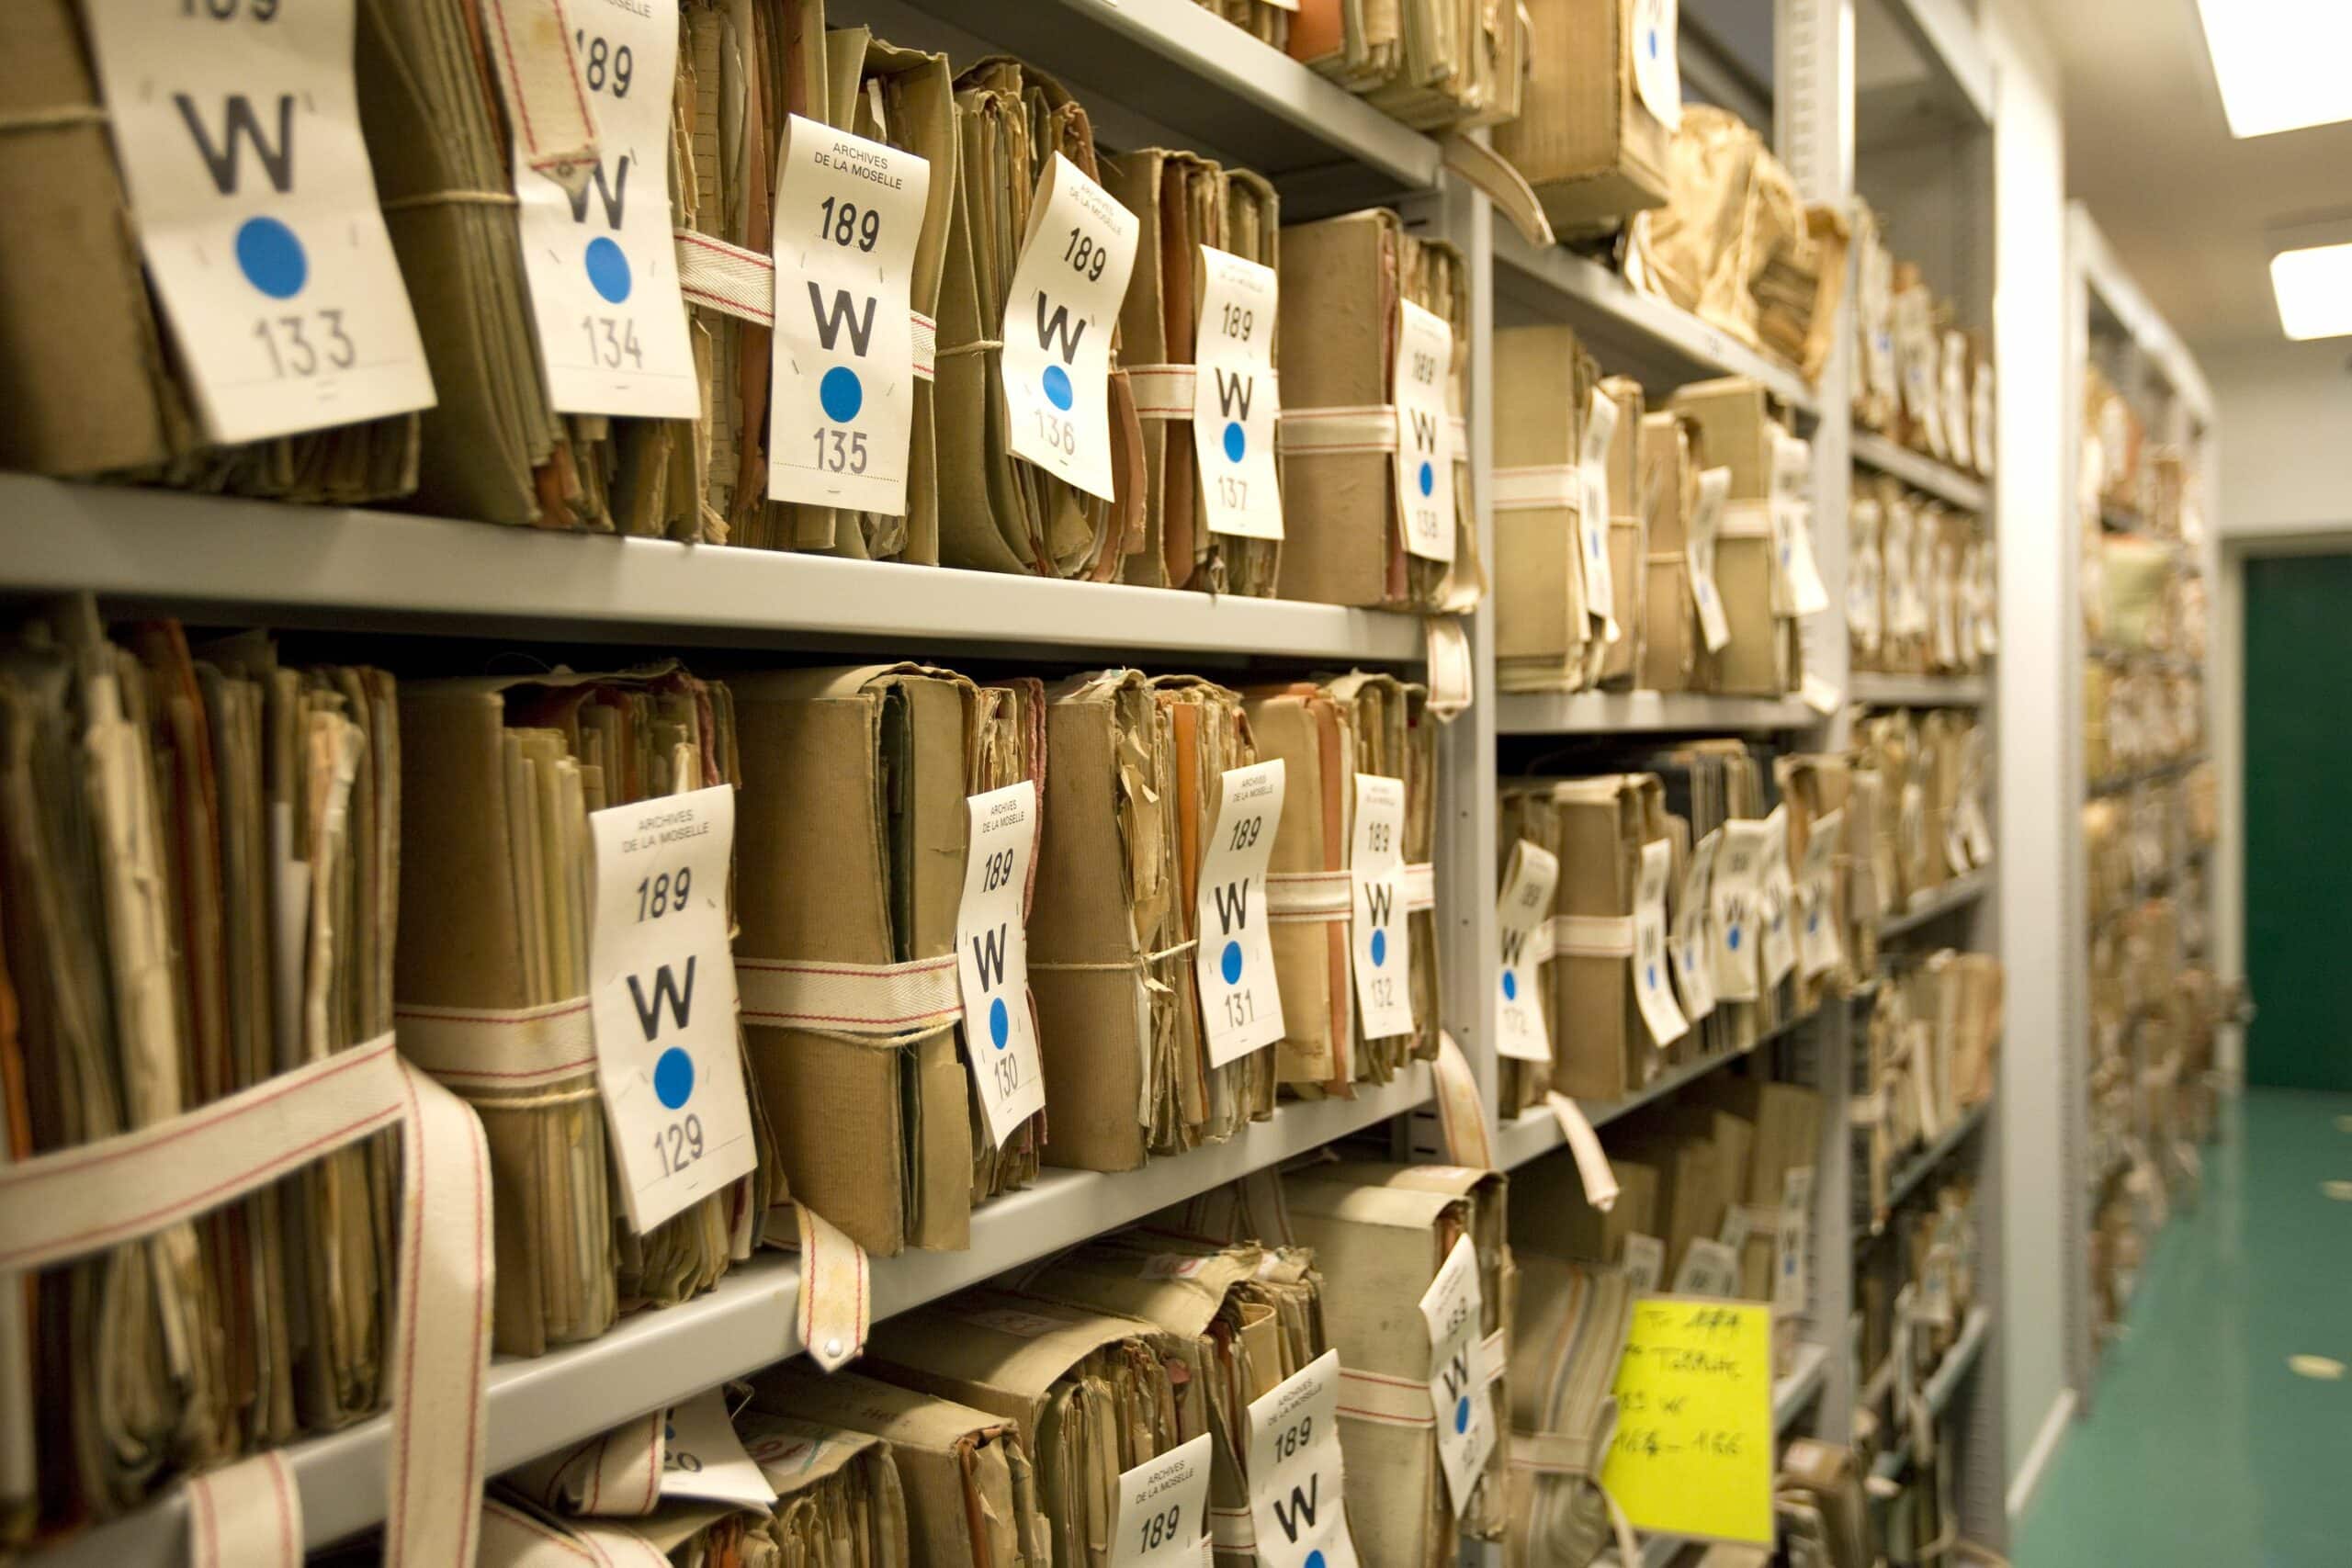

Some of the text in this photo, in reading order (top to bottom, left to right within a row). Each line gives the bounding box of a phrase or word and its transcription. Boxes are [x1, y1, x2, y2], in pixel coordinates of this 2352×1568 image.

[173, 93, 295, 195] W
[831, 142, 888, 170] ARCHIVES
[814, 152, 903, 190] DE LA MOSELLE
[821, 196, 880, 253] 189
[1064, 228, 1106, 282] 189
[254, 308, 356, 378] 133
[583, 316, 642, 369] 134
[807, 280, 876, 357] W
[1036, 290, 1087, 366] W
[1222, 302, 1253, 343] 189
[1215, 367, 1252, 422] W
[813, 427, 867, 474] 135
[1035, 408, 1075, 457] 136
[1409, 406, 1437, 456] W
[1218, 474, 1248, 511] 137
[639, 809, 694, 829] ARCHIVES
[982, 810, 1024, 834] DE LA MOSELLE
[991, 799, 1017, 816] ARCHIVES
[622, 820, 709, 853] DE LA MOSELLE
[1229, 815, 1262, 852] 189
[637, 866, 691, 923] 189
[983, 848, 1013, 893] 189
[1215, 877, 1250, 935] W
[1364, 882, 1392, 927] W
[973, 922, 1007, 993] W
[626, 954, 696, 1042] W
[1225, 988, 1255, 1029] 131
[994, 1052, 1019, 1102] 130
[653, 1113, 704, 1179] 129
[1443, 1341, 1469, 1404] W
[1274, 1416, 1312, 1463] 189
[1136, 1467, 1194, 1505] DE LA MOSELLE
[1148, 1460, 1185, 1486] ARCHIVES
[1140, 1505, 1181, 1554] 189
[1273, 1472, 1317, 1544] W
